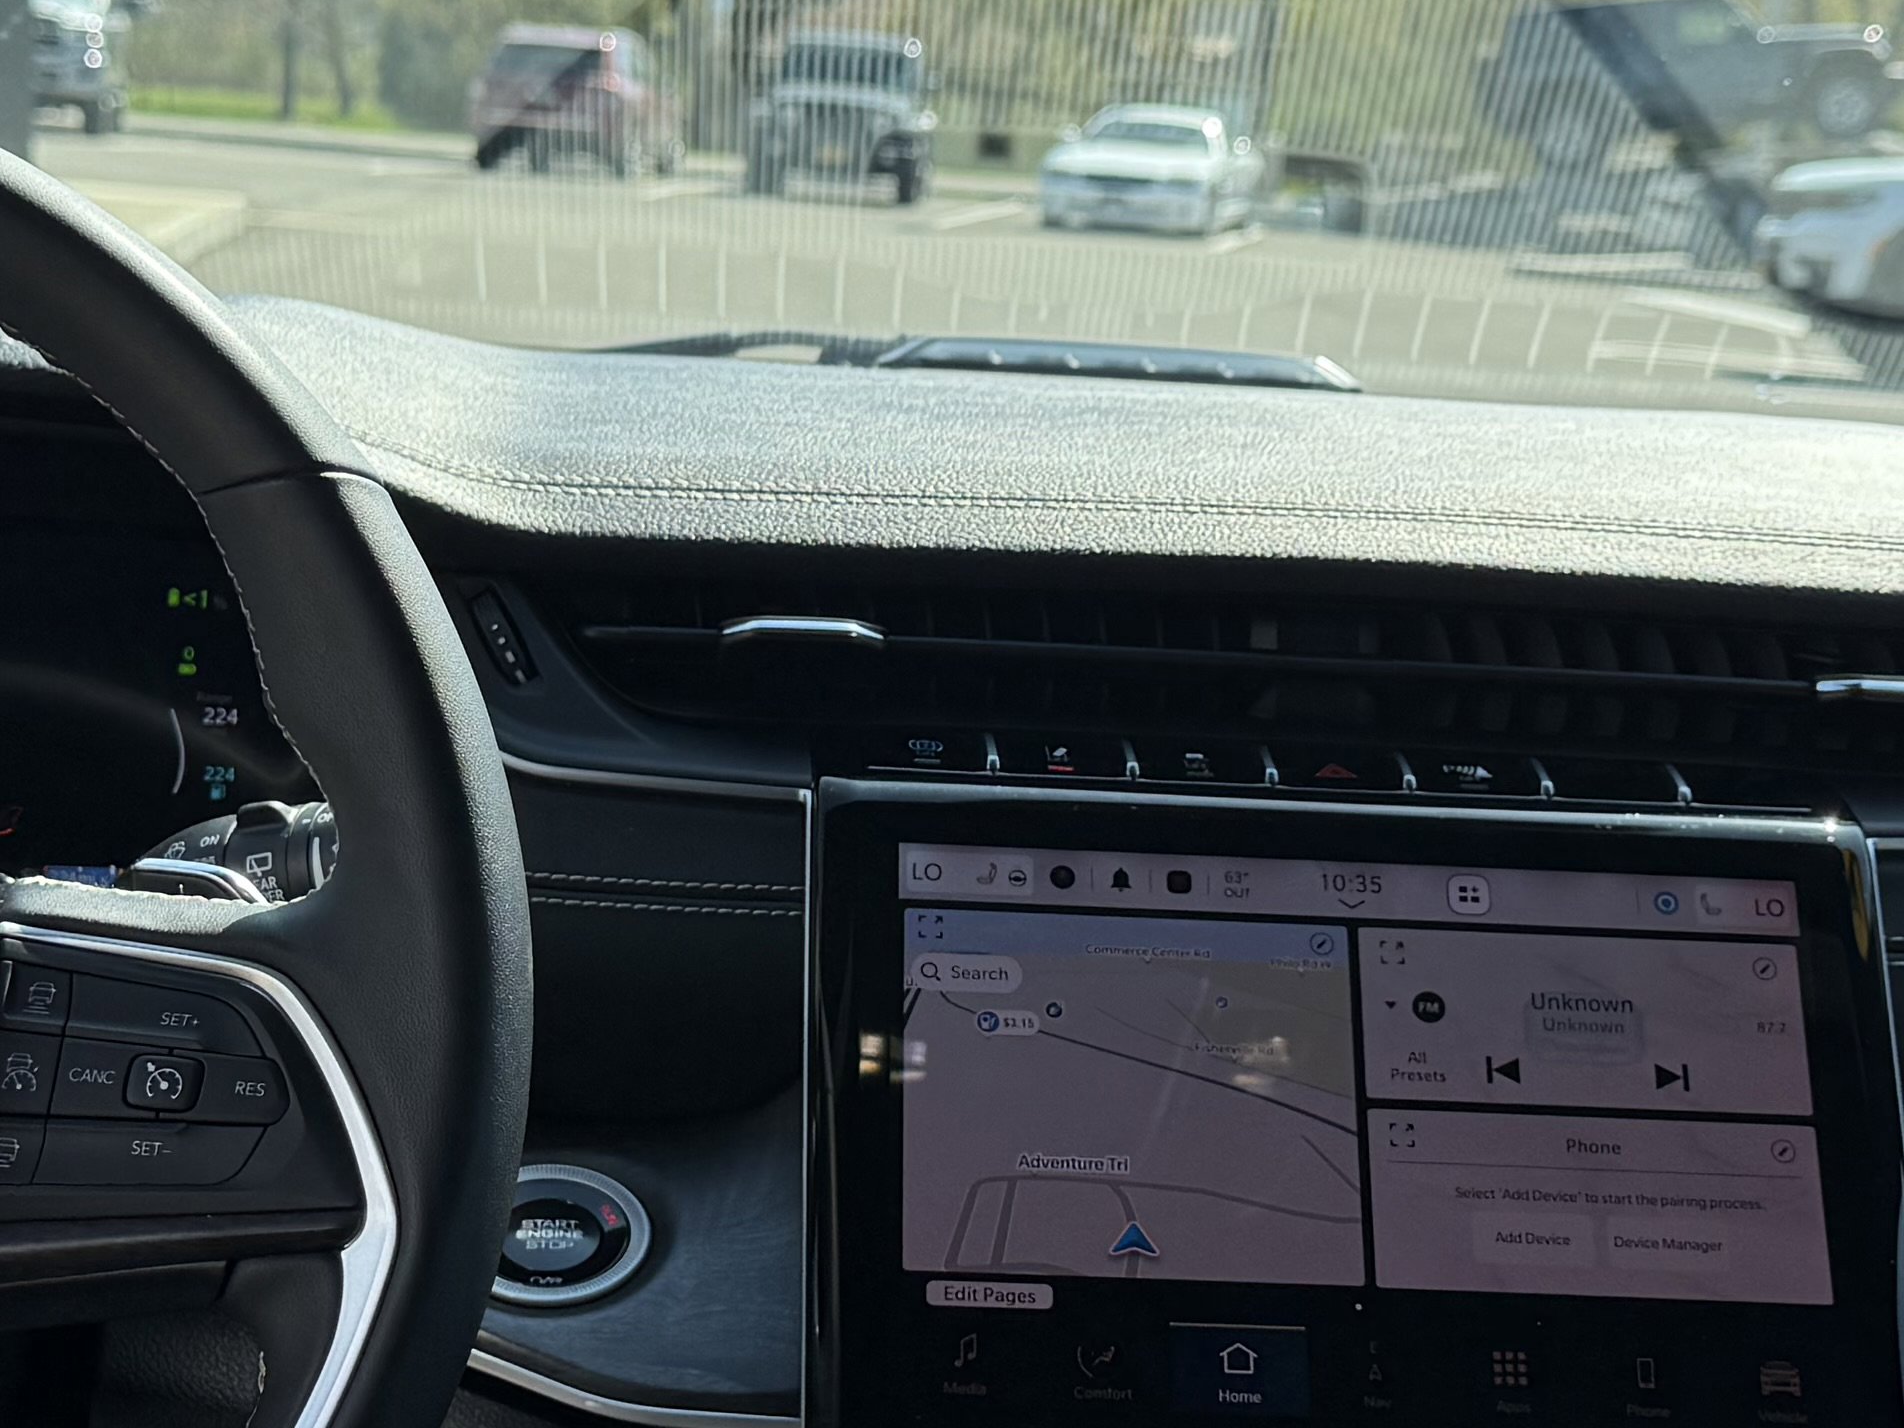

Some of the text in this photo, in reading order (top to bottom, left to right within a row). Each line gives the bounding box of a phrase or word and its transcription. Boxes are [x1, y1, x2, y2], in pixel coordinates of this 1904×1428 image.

[202, 707, 239, 727] 224
[202, 765, 236, 783] 224
[199, 833, 220, 847] ON
[911, 862, 1786, 918] LO 10:35 LO
[1224, 886, 1252, 899] OUT
[950, 964, 1010, 982] Search
[1531, 992, 1634, 1014] Unknown
[1542, 1016, 1626, 1035] Unknown
[1408, 1052, 1428, 1065] All
[68, 1067, 116, 1085] CANC
[1391, 1067, 1447, 1084] Presets
[234, 1081, 266, 1097] RES
[1565, 1137, 1622, 1156] Phone
[1018, 1153, 1105, 1172] Adventure
[1455, 1186, 1496, 1201] Select
[1601, 1194, 1633, 1206] start
[1635, 1194, 1658, 1207] the
[1660, 1196, 1707, 1211] pairing
[521, 1218, 580, 1229] START
[515, 1228, 584, 1240] ENGINE
[1495, 1230, 1723, 1254] Add Device Device Manager
[943, 1285, 1037, 1306] Edit Pages
[943, 1382, 987, 1398] Media
[1073, 1385, 1135, 1402] Comfort
[1218, 1389, 1264, 1404] Home
